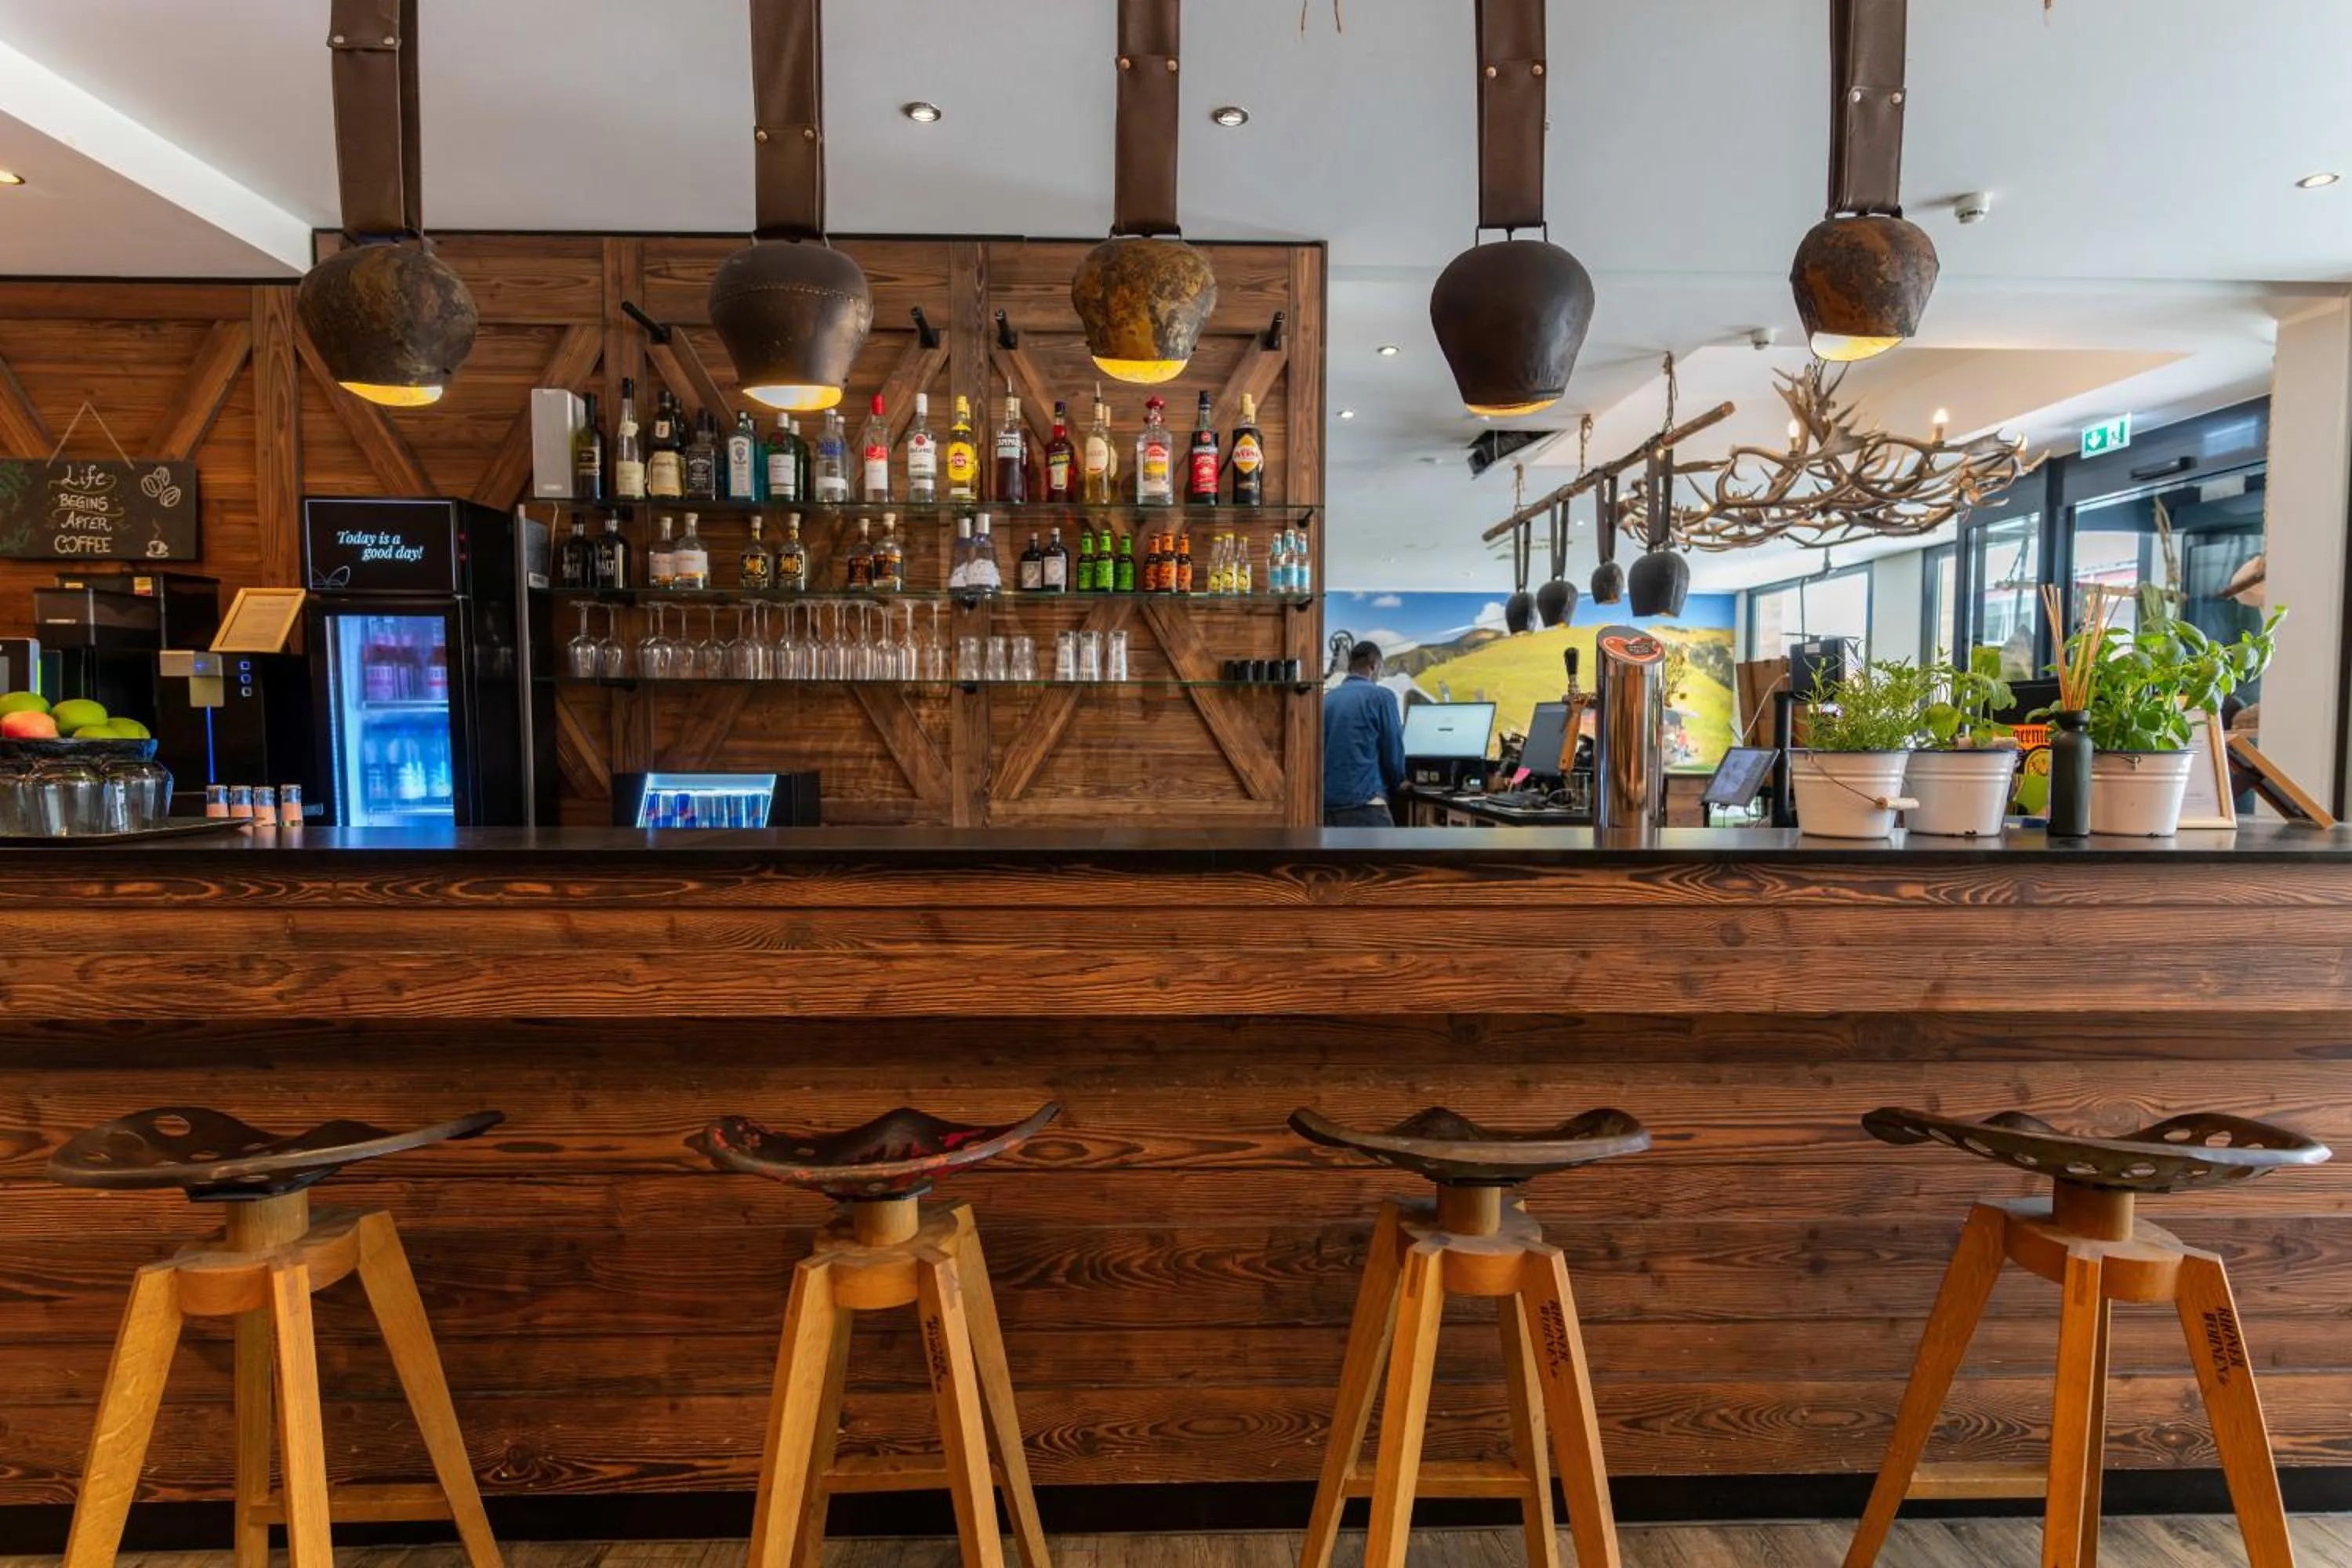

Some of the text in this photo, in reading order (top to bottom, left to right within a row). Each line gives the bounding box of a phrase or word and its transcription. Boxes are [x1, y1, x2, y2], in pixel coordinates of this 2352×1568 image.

[60, 464, 106, 489] Life
[58, 493, 109, 511] BEGINS
[60, 510, 111, 532] AFTER
[54, 535, 112, 554] COFFEE
[336, 530, 401, 546] Today is a
[361, 546, 424, 562] good day!
